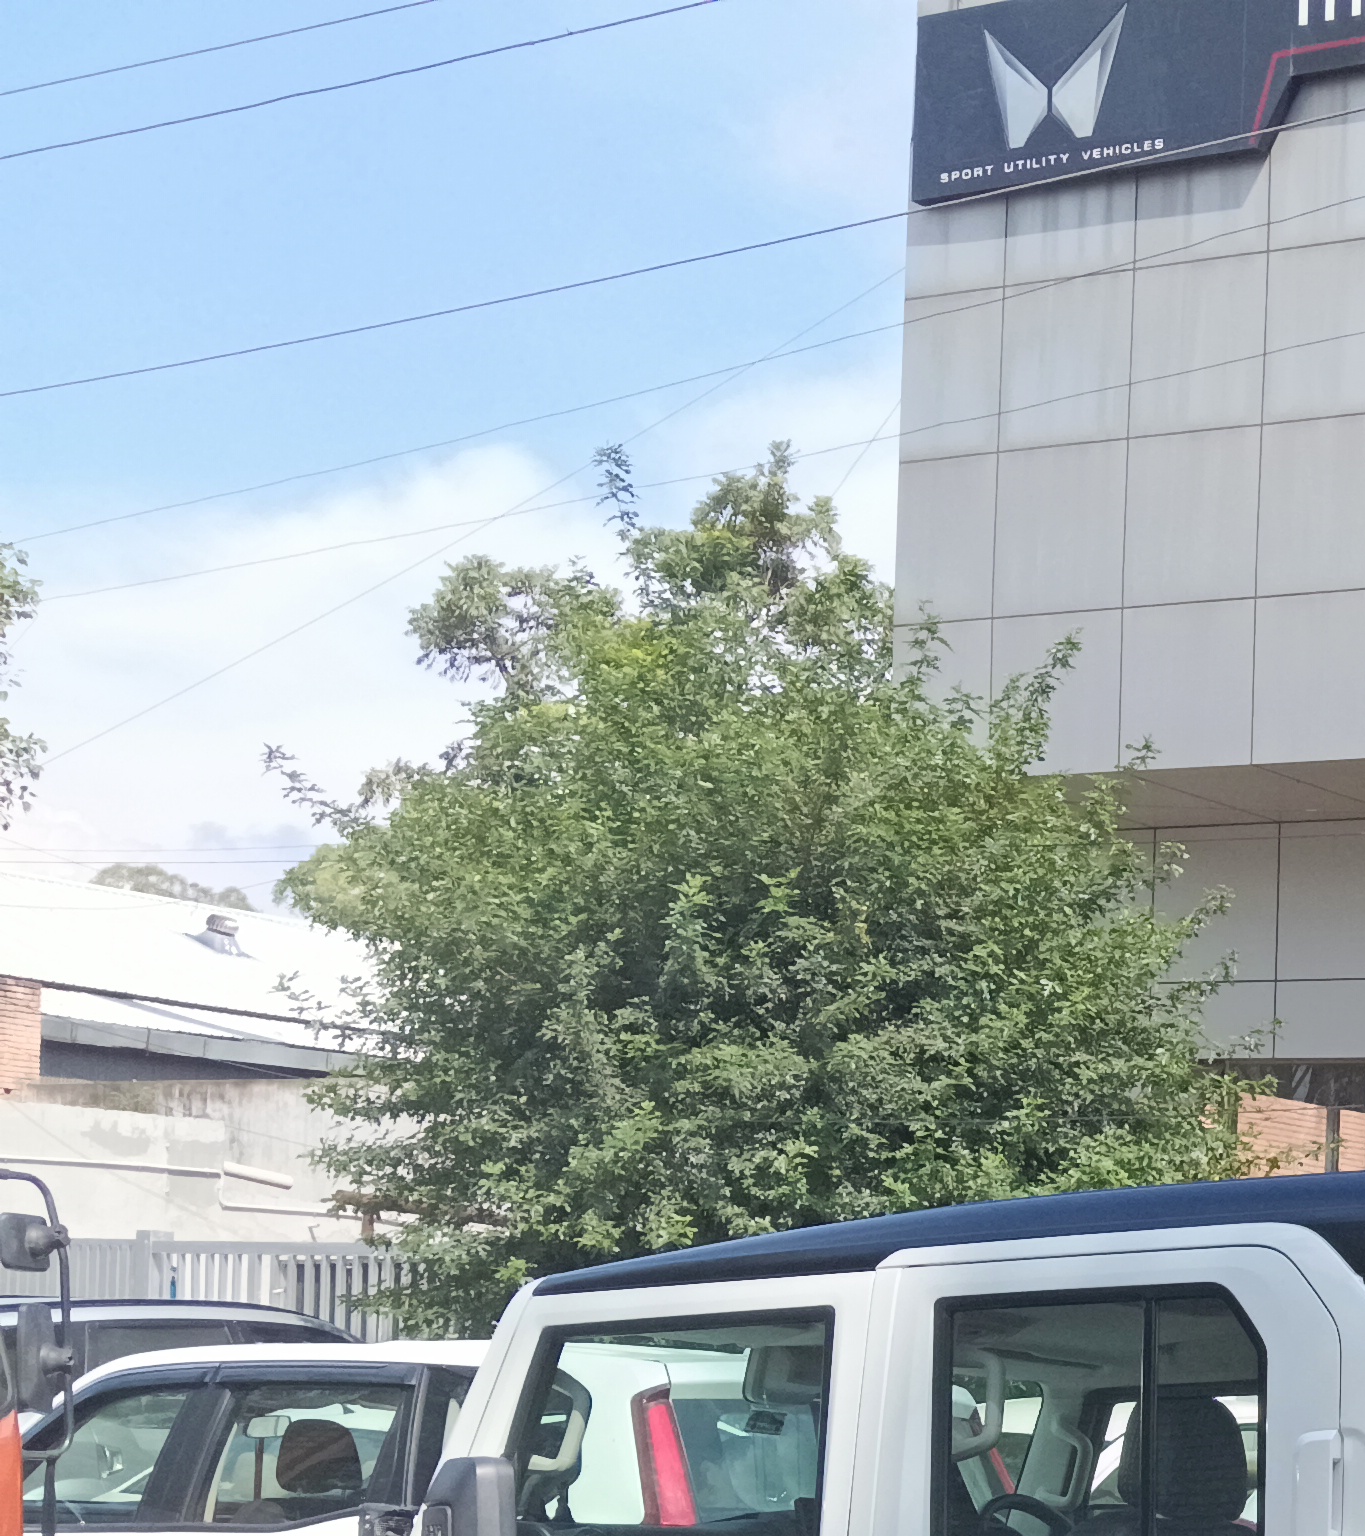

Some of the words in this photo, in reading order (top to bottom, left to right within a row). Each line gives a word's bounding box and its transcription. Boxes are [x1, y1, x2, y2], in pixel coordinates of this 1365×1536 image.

[939, 164, 994, 184] SPORT
[1004, 152, 1070, 174] UTILITY
[1081, 138, 1165, 161] VEHICLES
